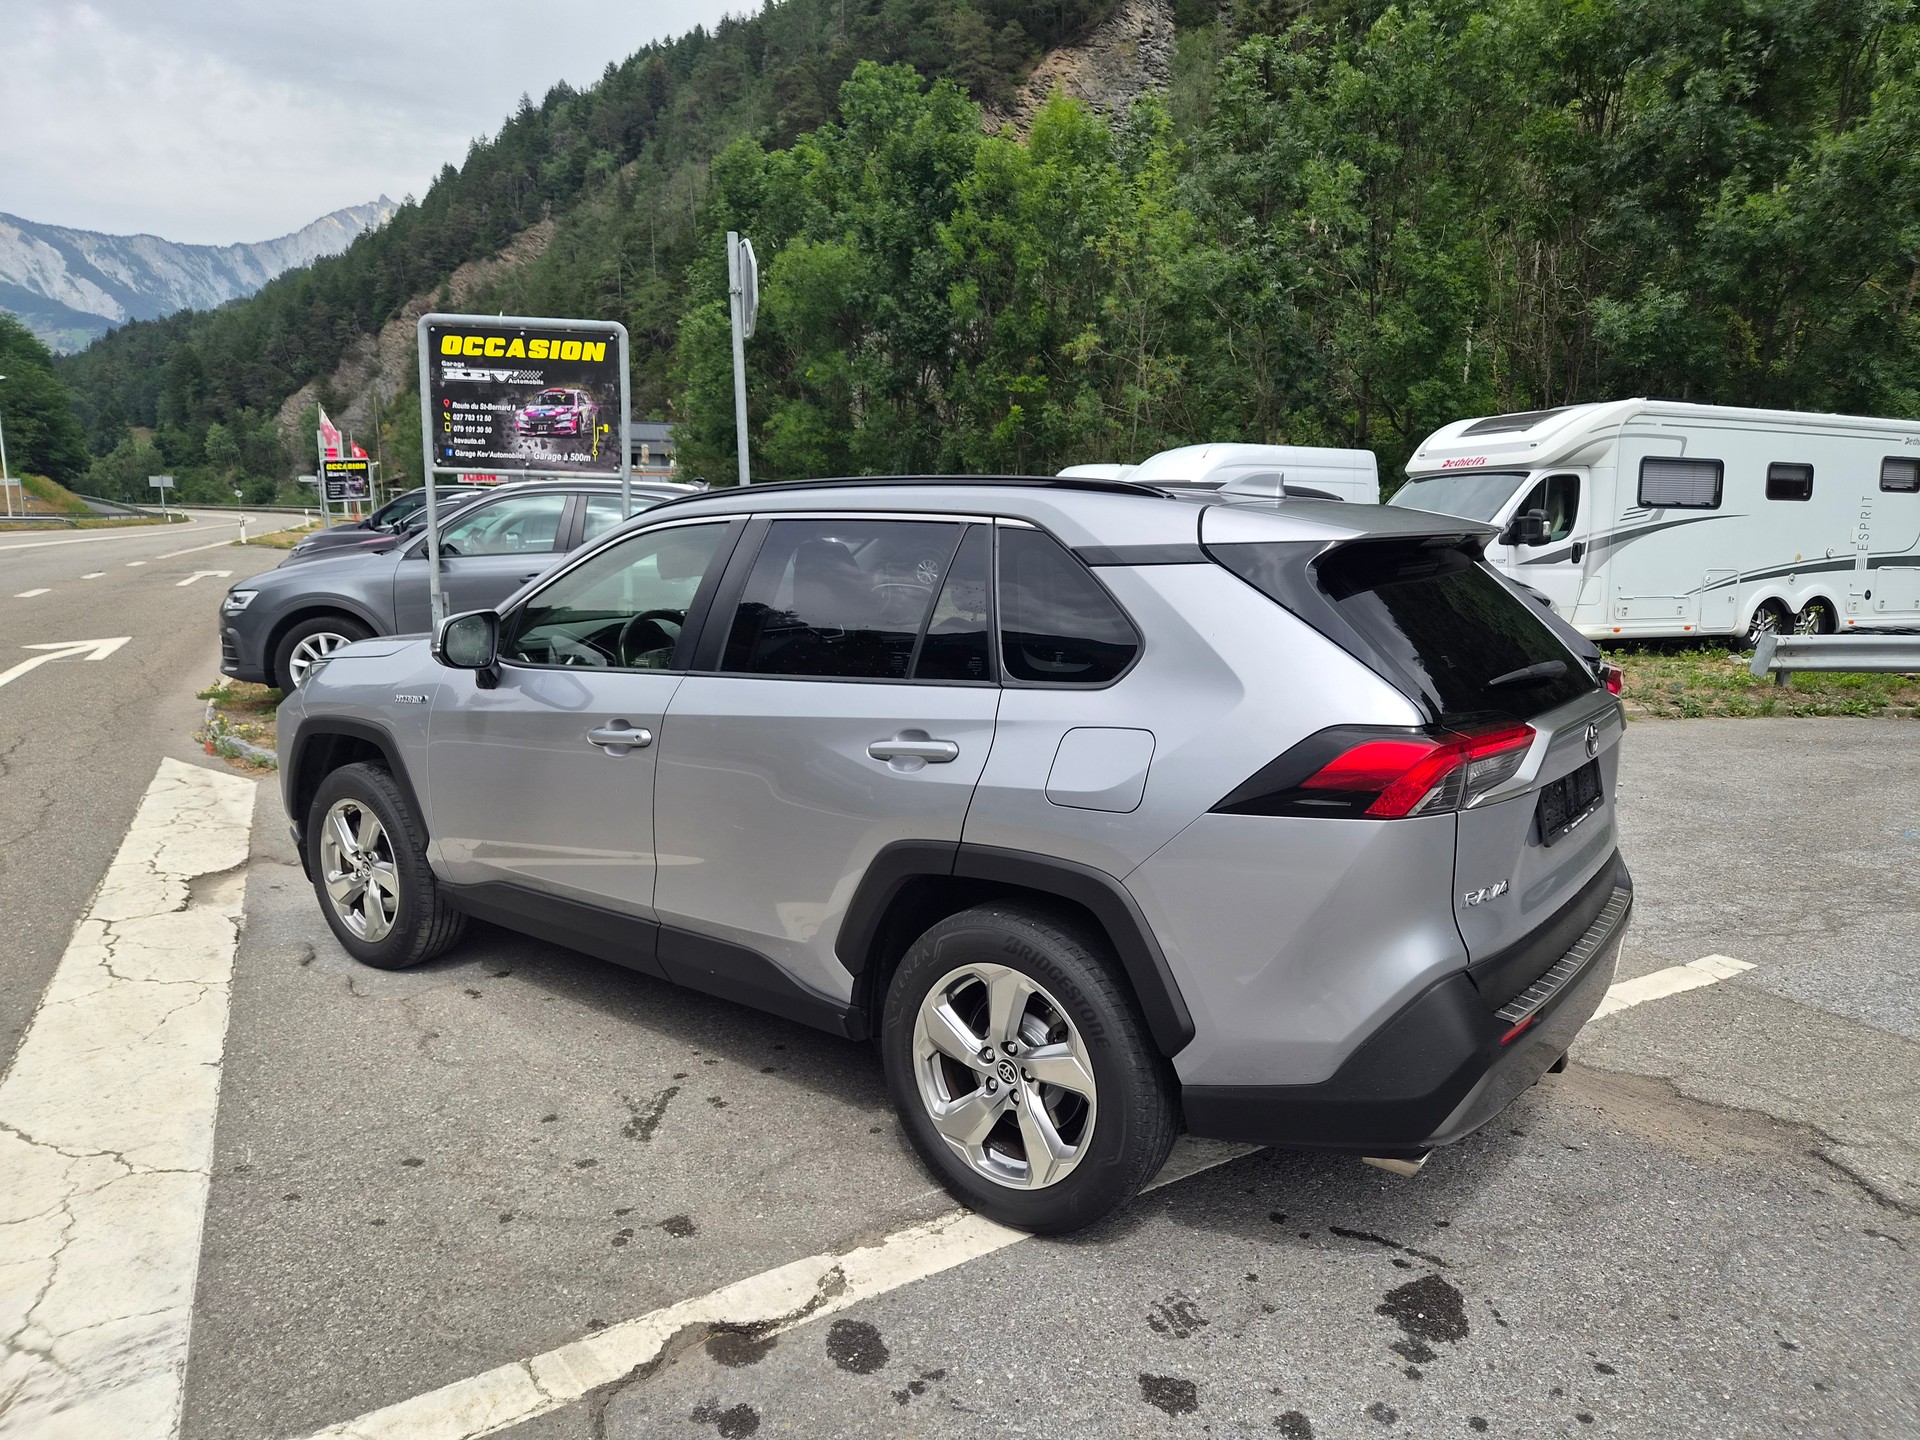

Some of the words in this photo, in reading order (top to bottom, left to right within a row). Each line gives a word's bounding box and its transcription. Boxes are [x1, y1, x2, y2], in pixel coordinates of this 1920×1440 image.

[440, 335, 606, 362] OCCASION
[441, 360, 465, 368] Garage
[452, 401, 470, 410] Route
[470, 402, 479, 410] du
[479, 403, 511, 412] St-Bernard
[452, 413, 464, 421] 027
[476, 414, 484, 422] 12
[465, 425, 476, 434] 101
[453, 436, 486, 446] kevauto.ch
[455, 449, 477, 459] Garage
[533, 452, 562, 462] Garage
[563, 452, 569, 461] à
[570, 453, 592, 462] 500m
[1441, 456, 1488, 468] Dethleffs
[1857, 495, 1873, 551] ESPRIT
[1461, 879, 1510, 910] RAV4
[890, 946, 930, 1012] ALENZA
[1002, 935, 1113, 1049] BRIDGESTONE
